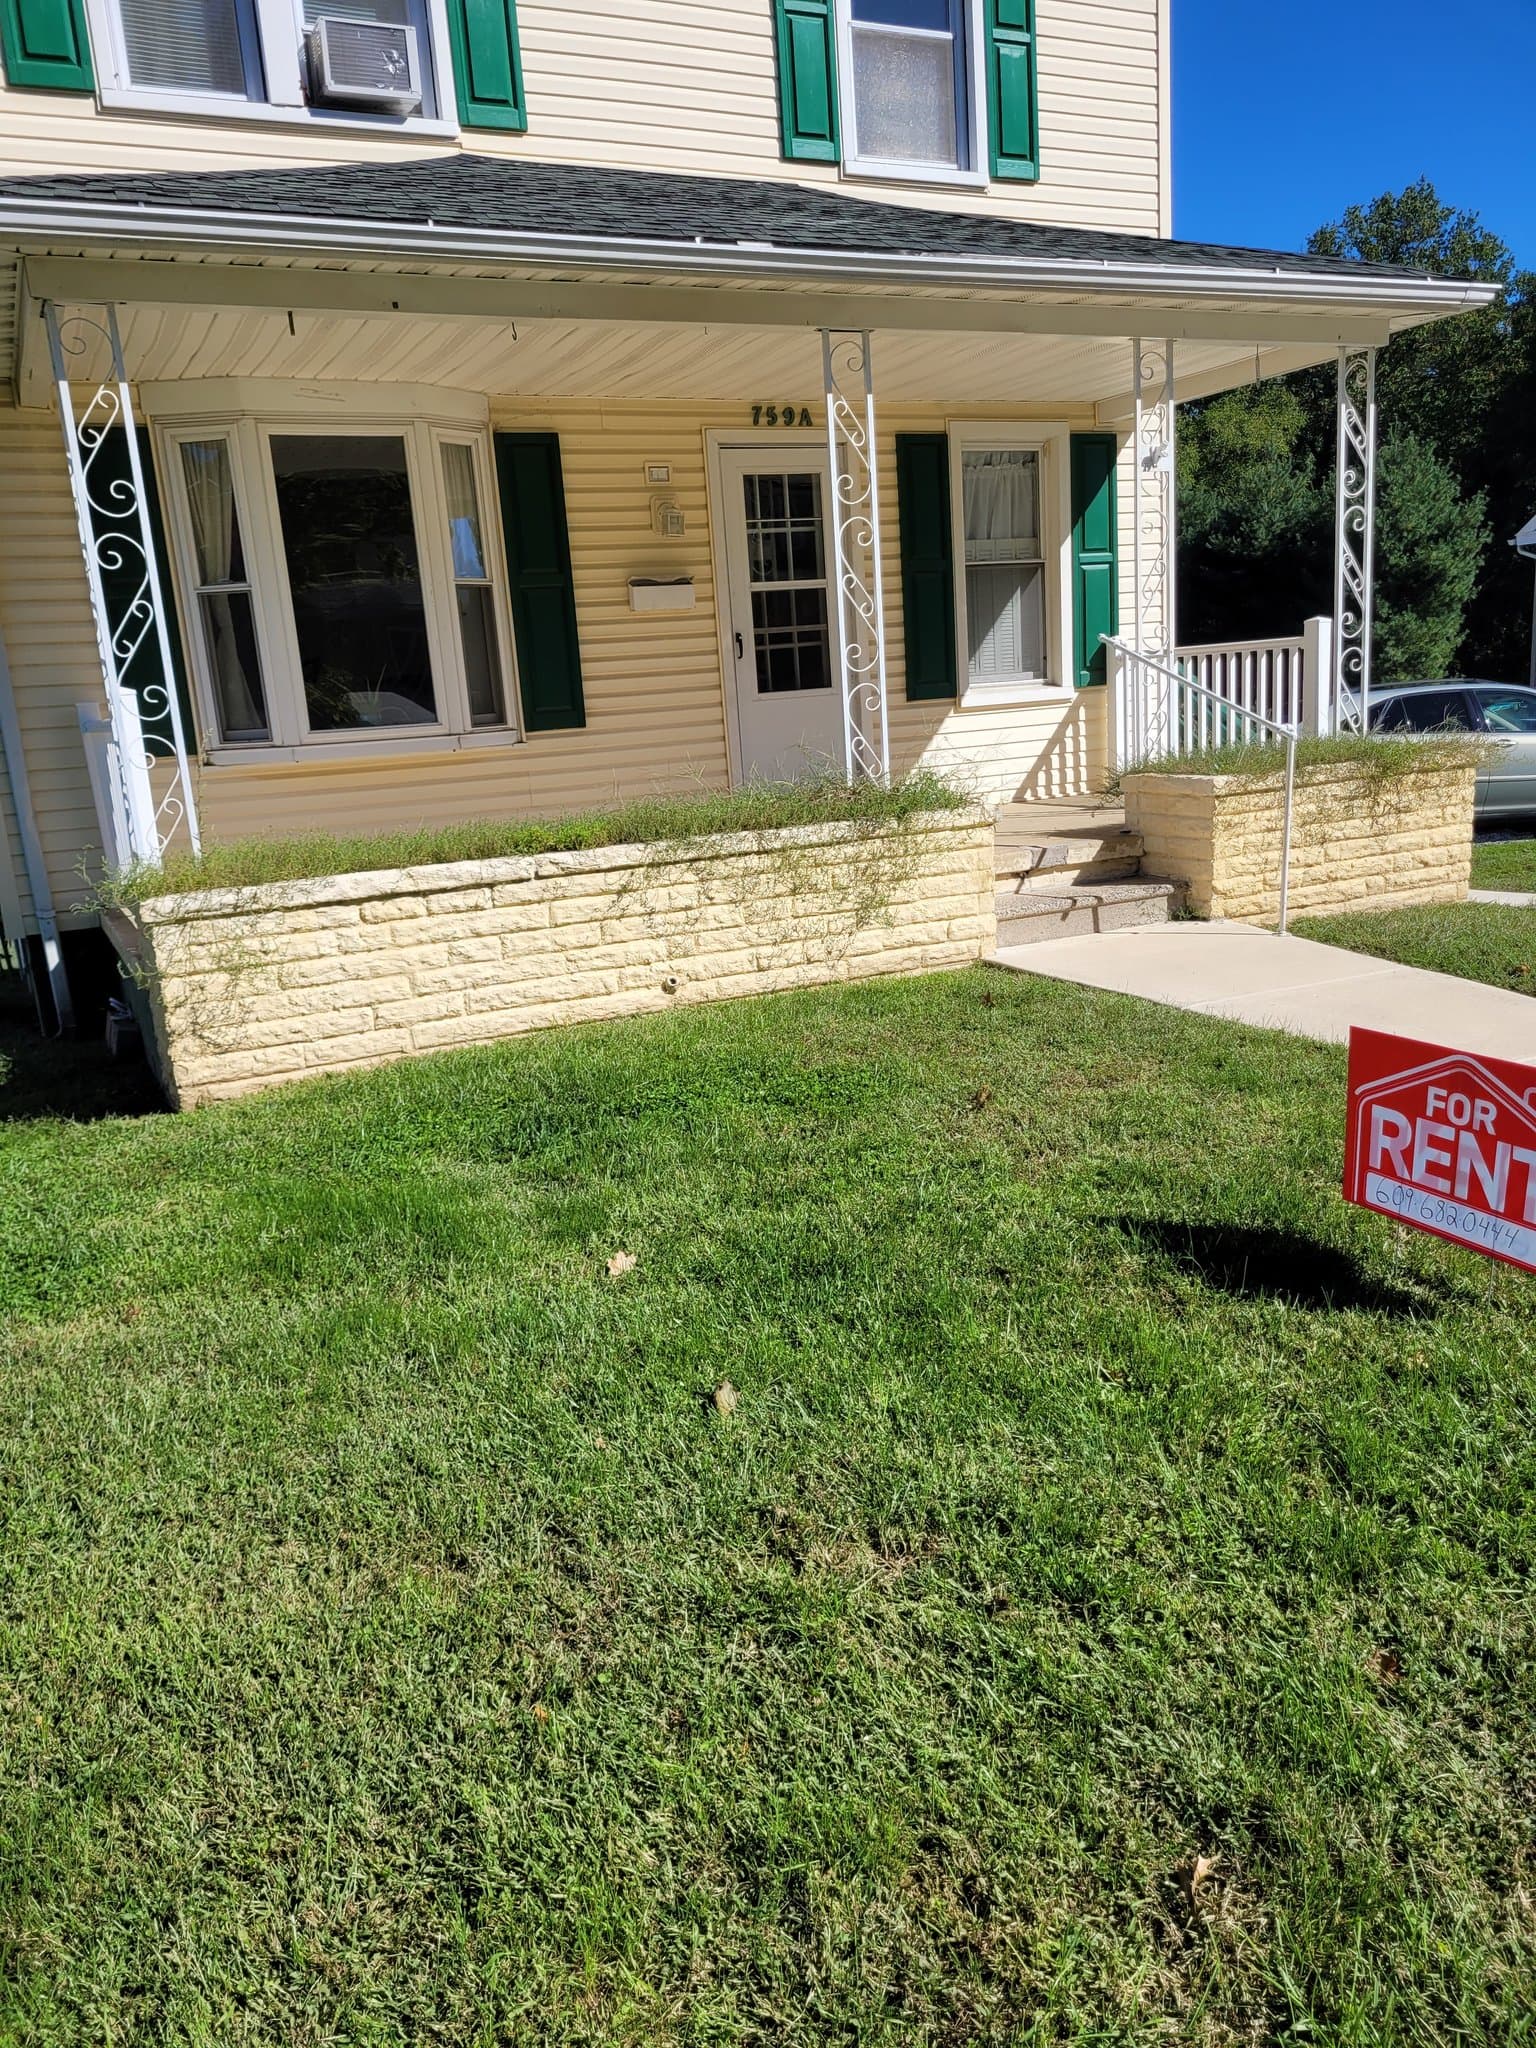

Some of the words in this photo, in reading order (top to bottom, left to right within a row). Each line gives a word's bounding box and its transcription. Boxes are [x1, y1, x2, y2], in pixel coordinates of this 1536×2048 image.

[751, 405, 813, 427] 759A
[1425, 1085, 1498, 1136] FOR
[1368, 1103, 1536, 1225] RENT
